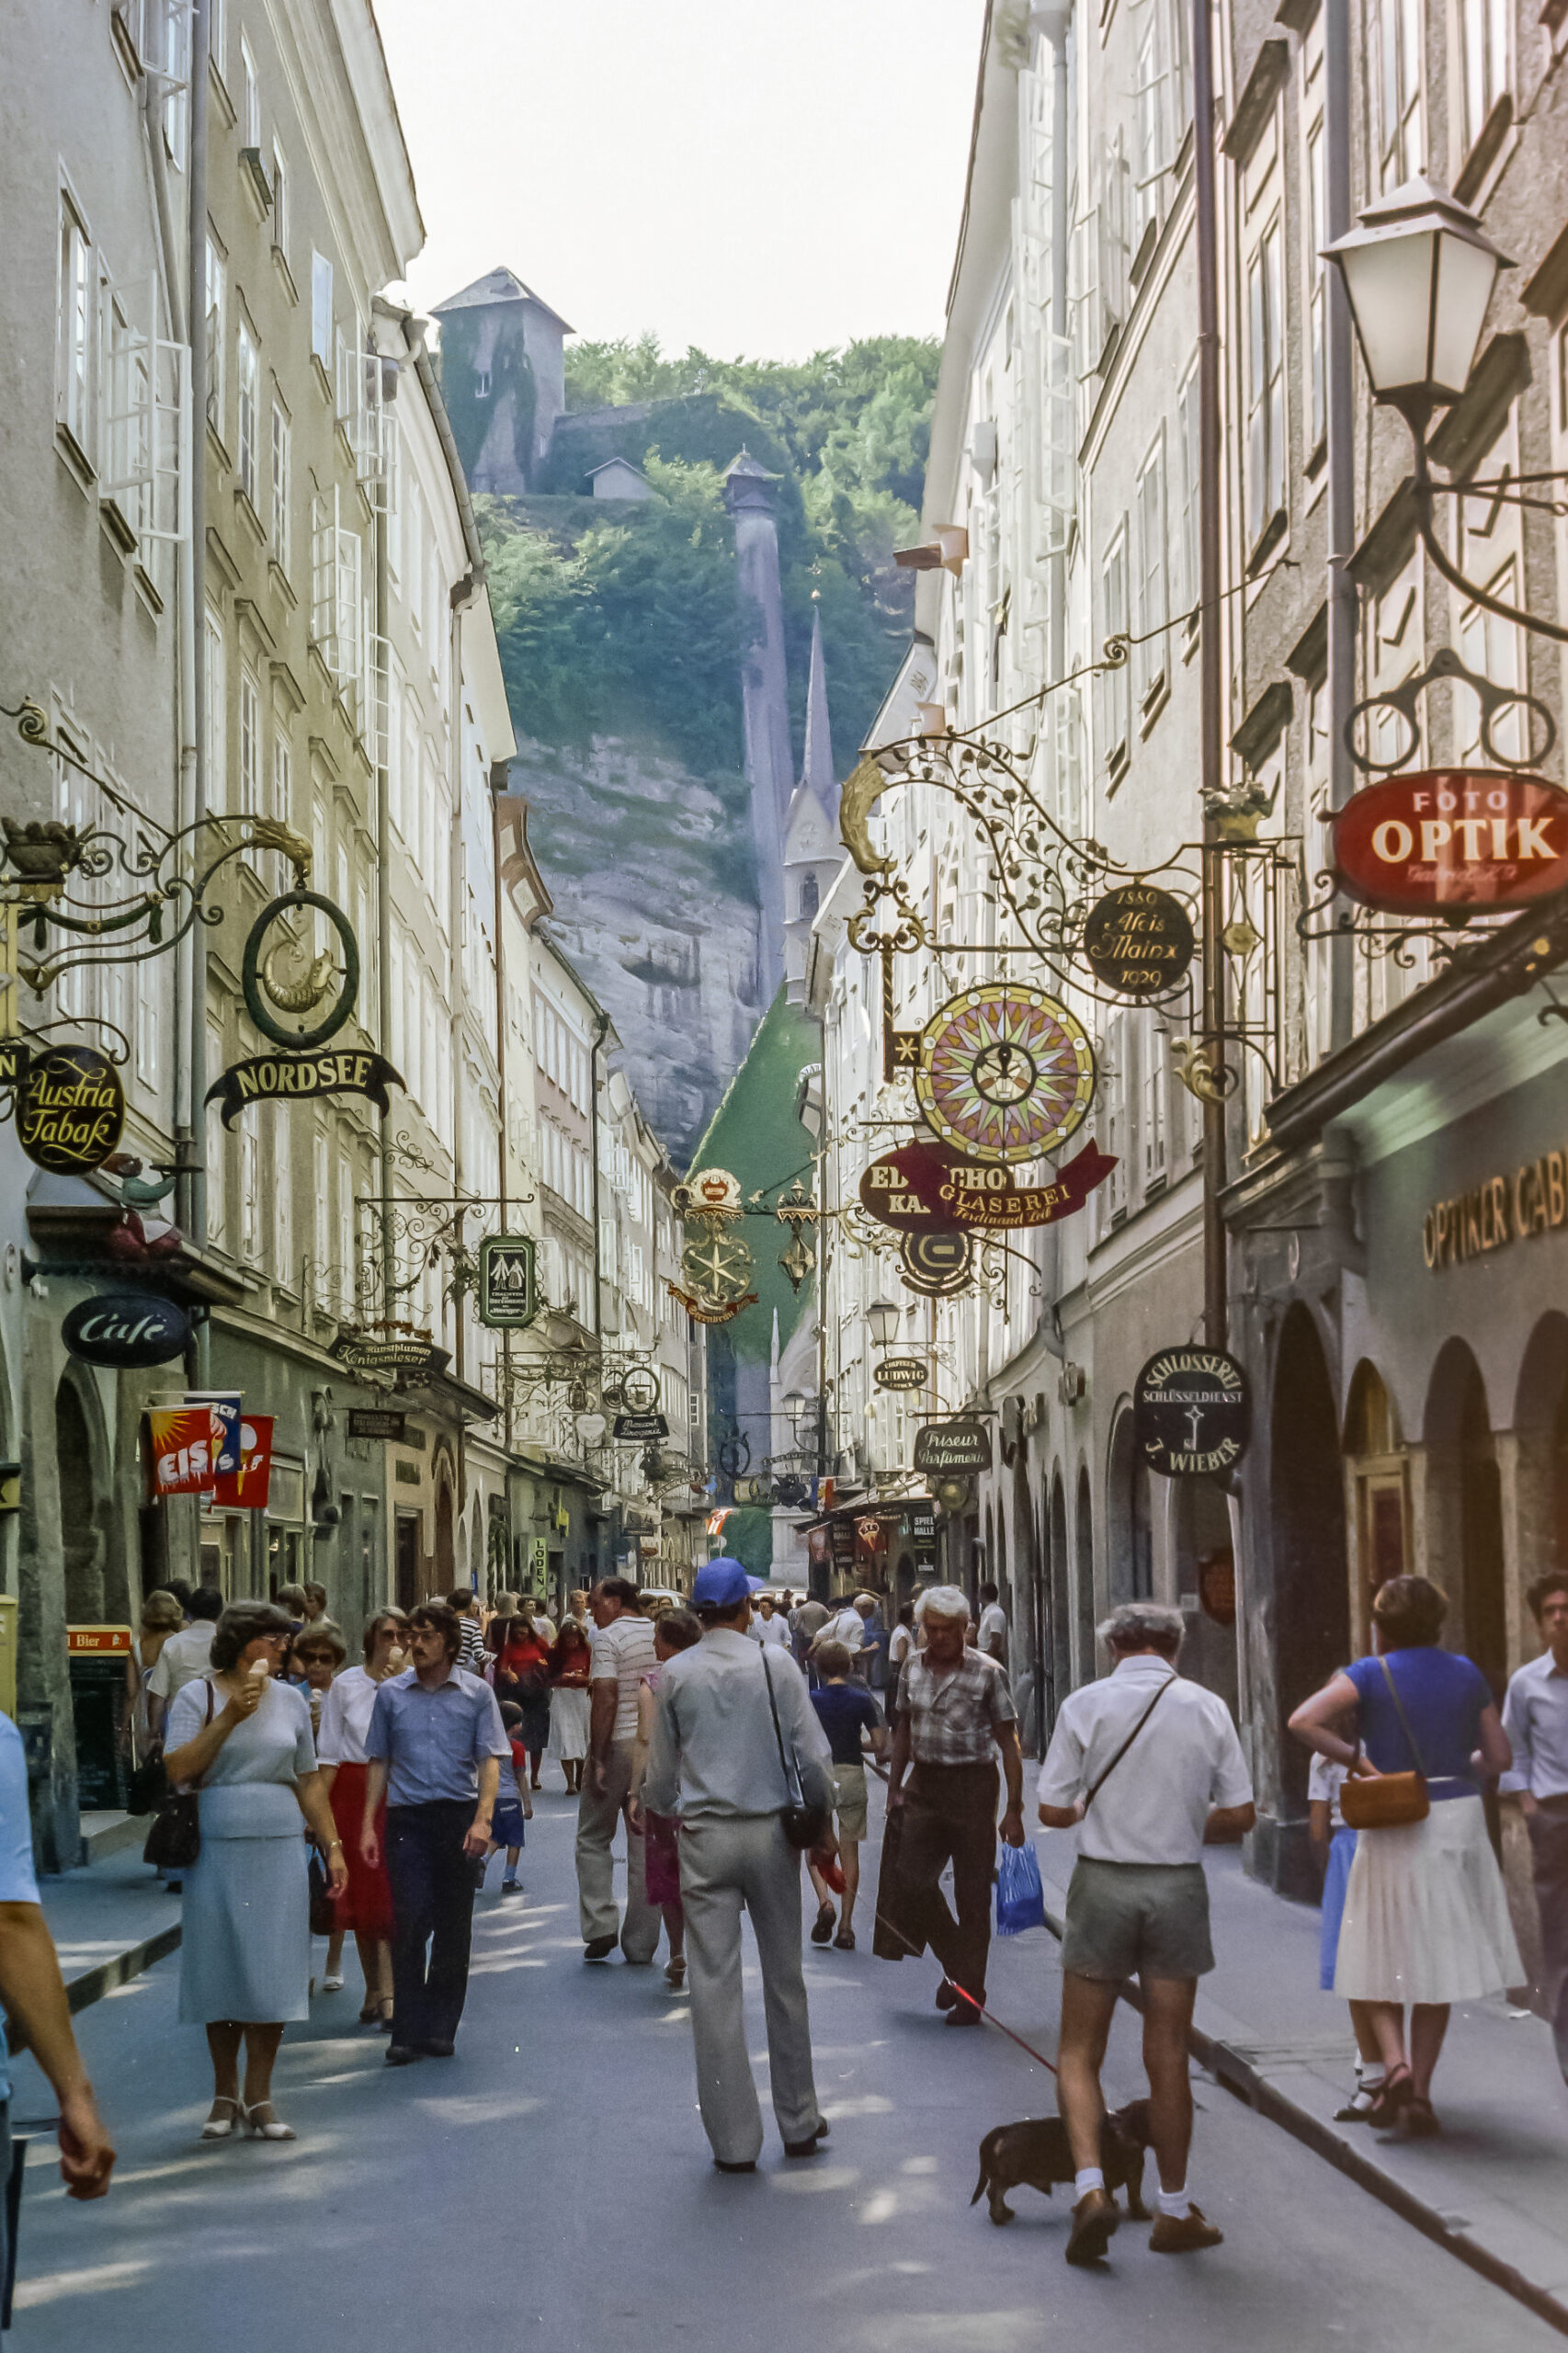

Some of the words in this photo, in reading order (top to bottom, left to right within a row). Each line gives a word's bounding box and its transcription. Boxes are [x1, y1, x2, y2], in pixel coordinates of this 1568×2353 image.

[1413, 790, 1508, 813] FOTO
[1371, 816, 1562, 864] OPTIK
[1119, 911, 1165, 932] Alois
[1121, 971, 1162, 988] 1929
[28, 1069, 116, 1108] Austria
[236, 1055, 373, 1098] NORDSEE
[22, 1108, 117, 1155] Tabak
[939, 1184, 1071, 1213] GLASEREI
[1424, 1176, 1508, 1268] OPTIKER
[877, 1370, 925, 1381] LUDWIG
[1146, 1354, 1242, 1390] SCHLOSSEREI
[1142, 1390, 1244, 1404] SCHLÜSSELDIENST
[924, 1430, 979, 1448] Friseur
[1170, 1437, 1240, 1472] WIEBER
[157, 1440, 209, 1489] EIS
[536, 1540, 545, 1586] LODEN
[76, 1634, 99, 1646] Bier
